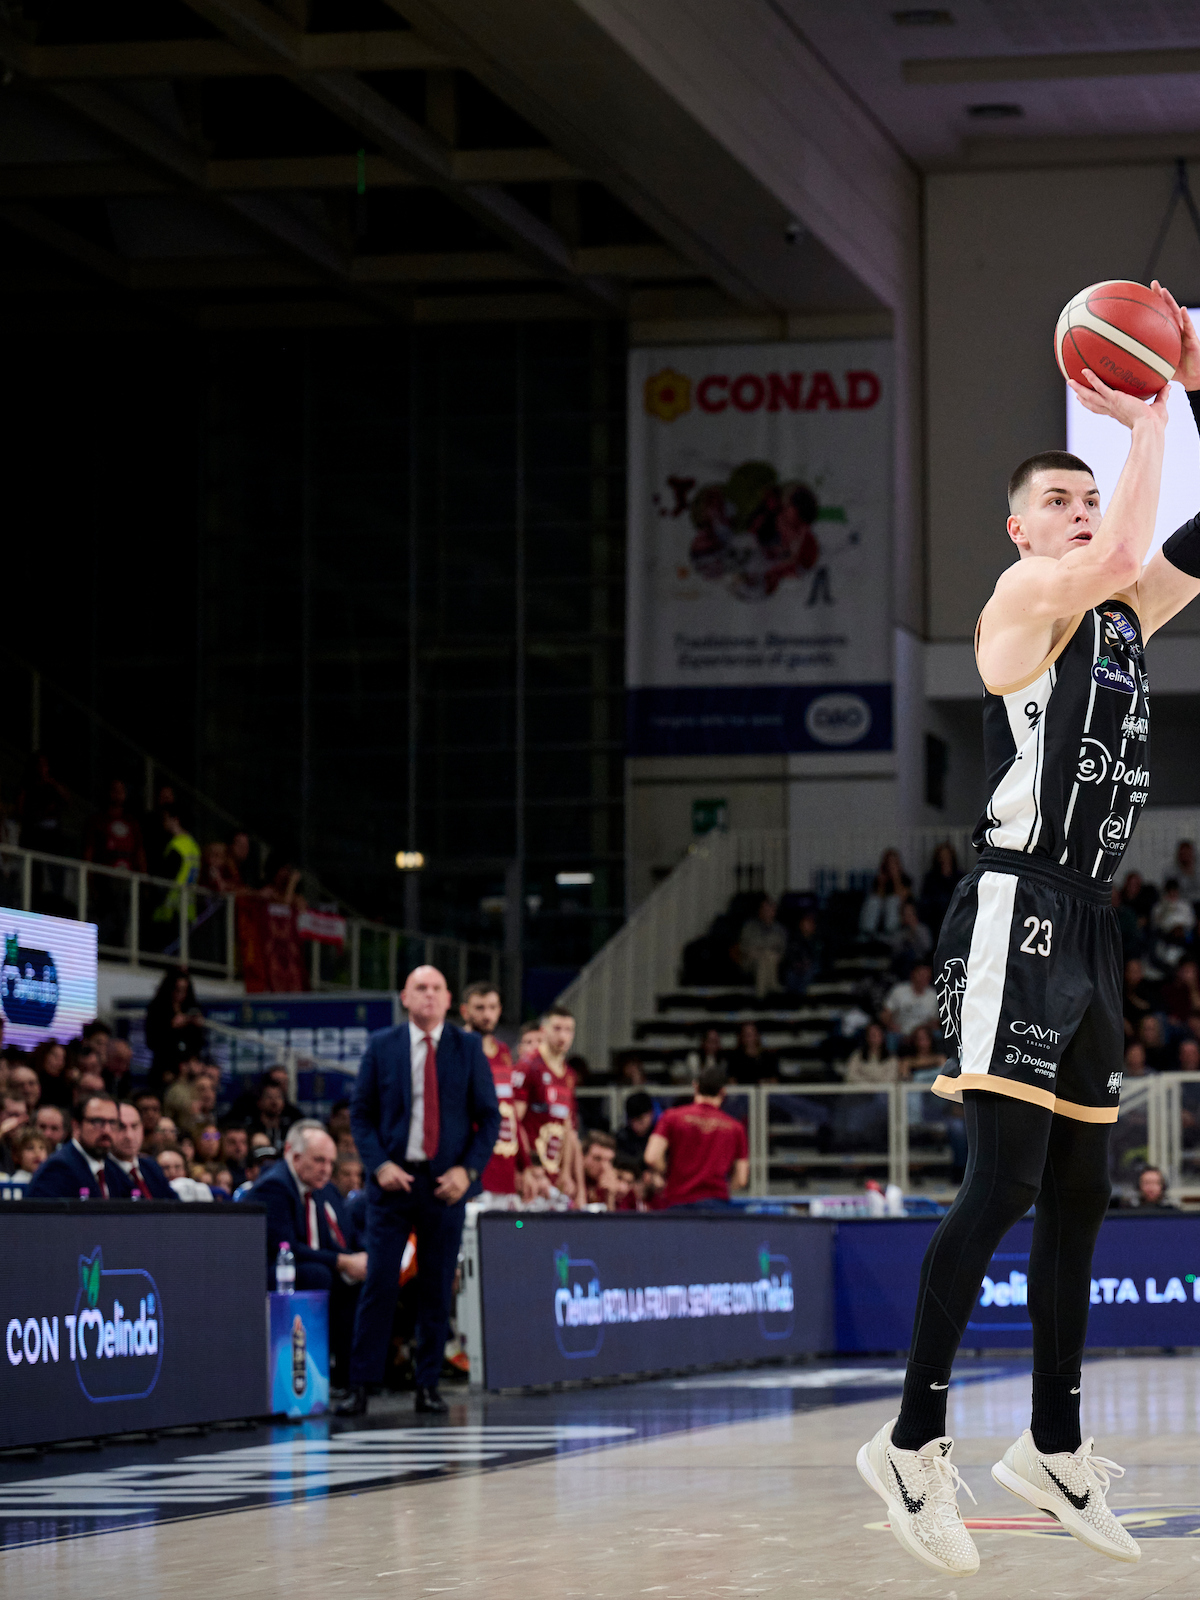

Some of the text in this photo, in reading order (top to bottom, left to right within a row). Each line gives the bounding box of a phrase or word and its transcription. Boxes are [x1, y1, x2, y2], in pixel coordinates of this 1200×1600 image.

[1098, 356, 1147, 391] molten
[697, 369, 882, 414] CONAD
[1021, 915, 1054, 957] 23
[1009, 1020, 1061, 1045] CAVIT
[1026, 1039, 1052, 1050] TRENTO
[1146, 1277, 1187, 1303] LA
[6, 1315, 59, 1365] CON
[78, 1297, 158, 1361] Melinda
